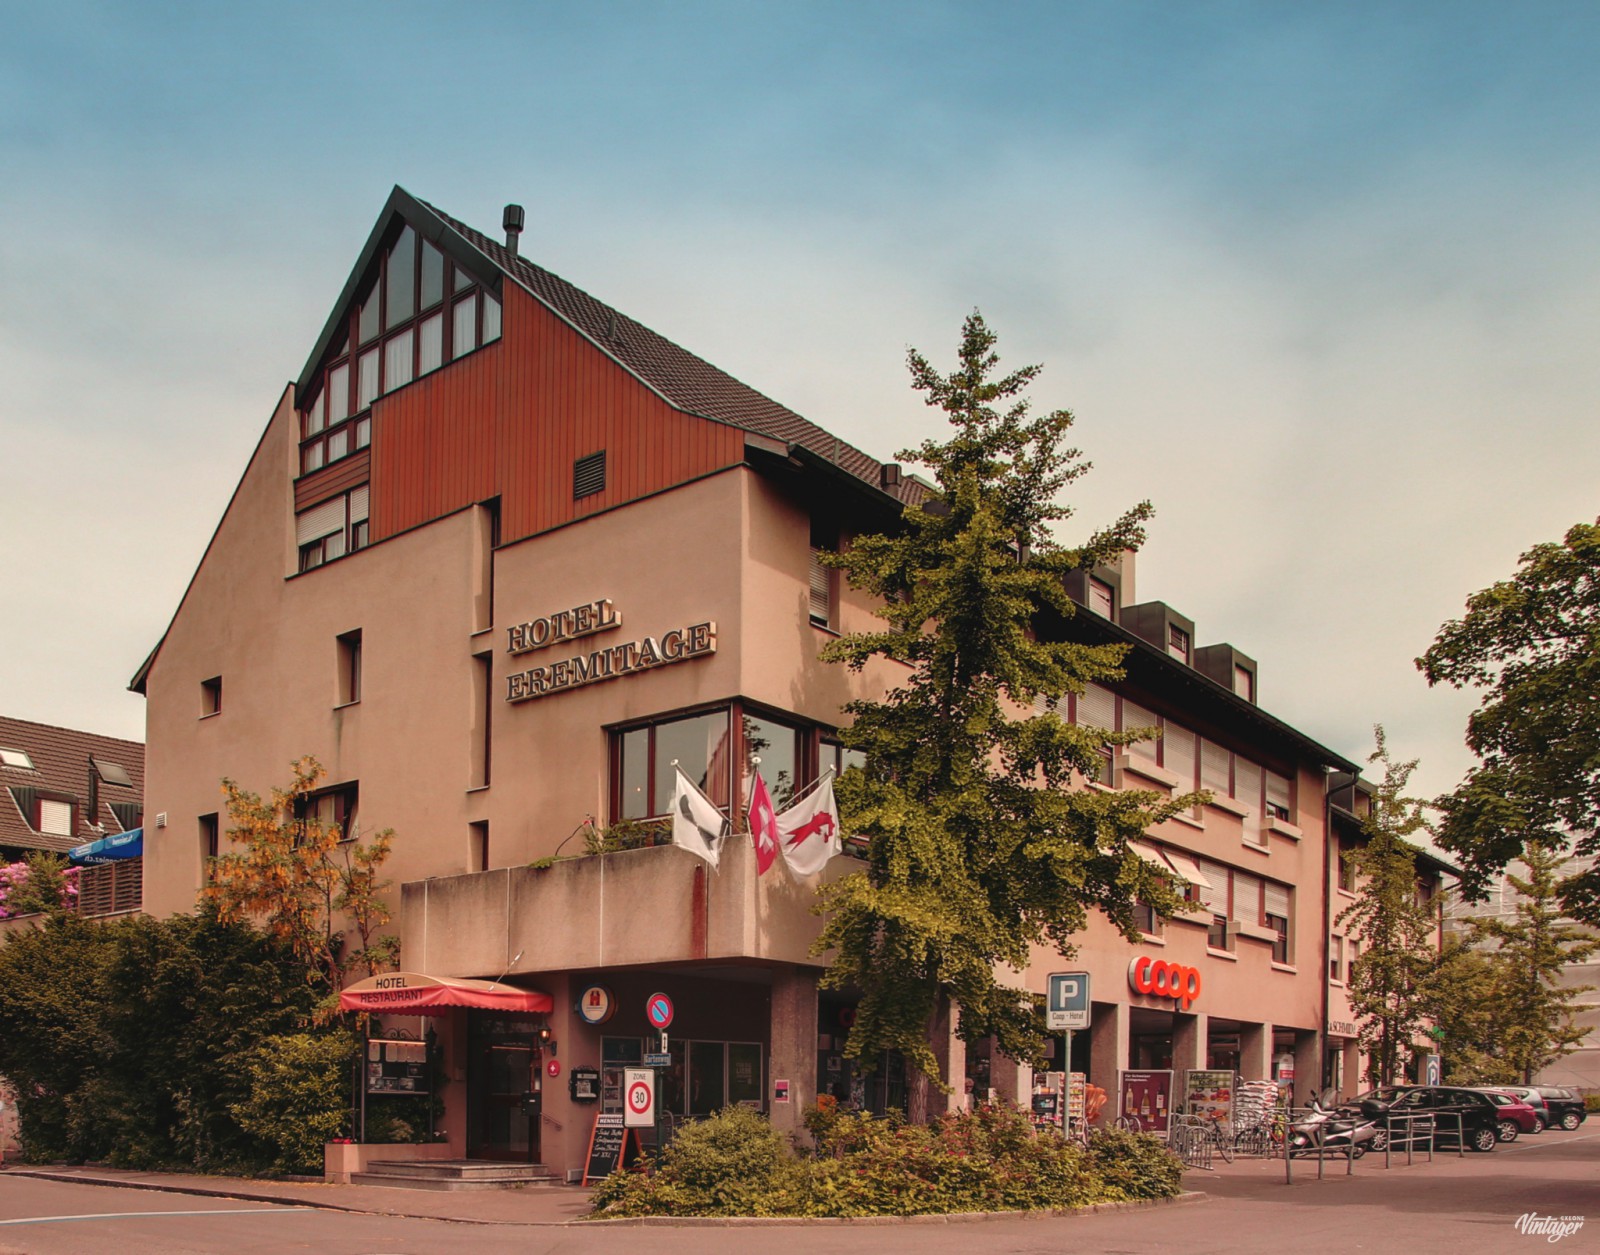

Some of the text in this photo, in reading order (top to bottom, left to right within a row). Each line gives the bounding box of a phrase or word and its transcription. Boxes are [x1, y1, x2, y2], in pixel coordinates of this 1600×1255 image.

[506, 599, 622, 656] HOTEL
[505, 621, 717, 703] EREMITAGE
[376, 977, 408, 990] HOTEL
[360, 989, 425, 1003] RESTAURANT
[1060, 980, 1078, 1008] P
[1052, 1012, 1065, 1021] Coop
[1069, 1012, 1084, 1020] Hotel
[635, 1092, 645, 1104] 30
